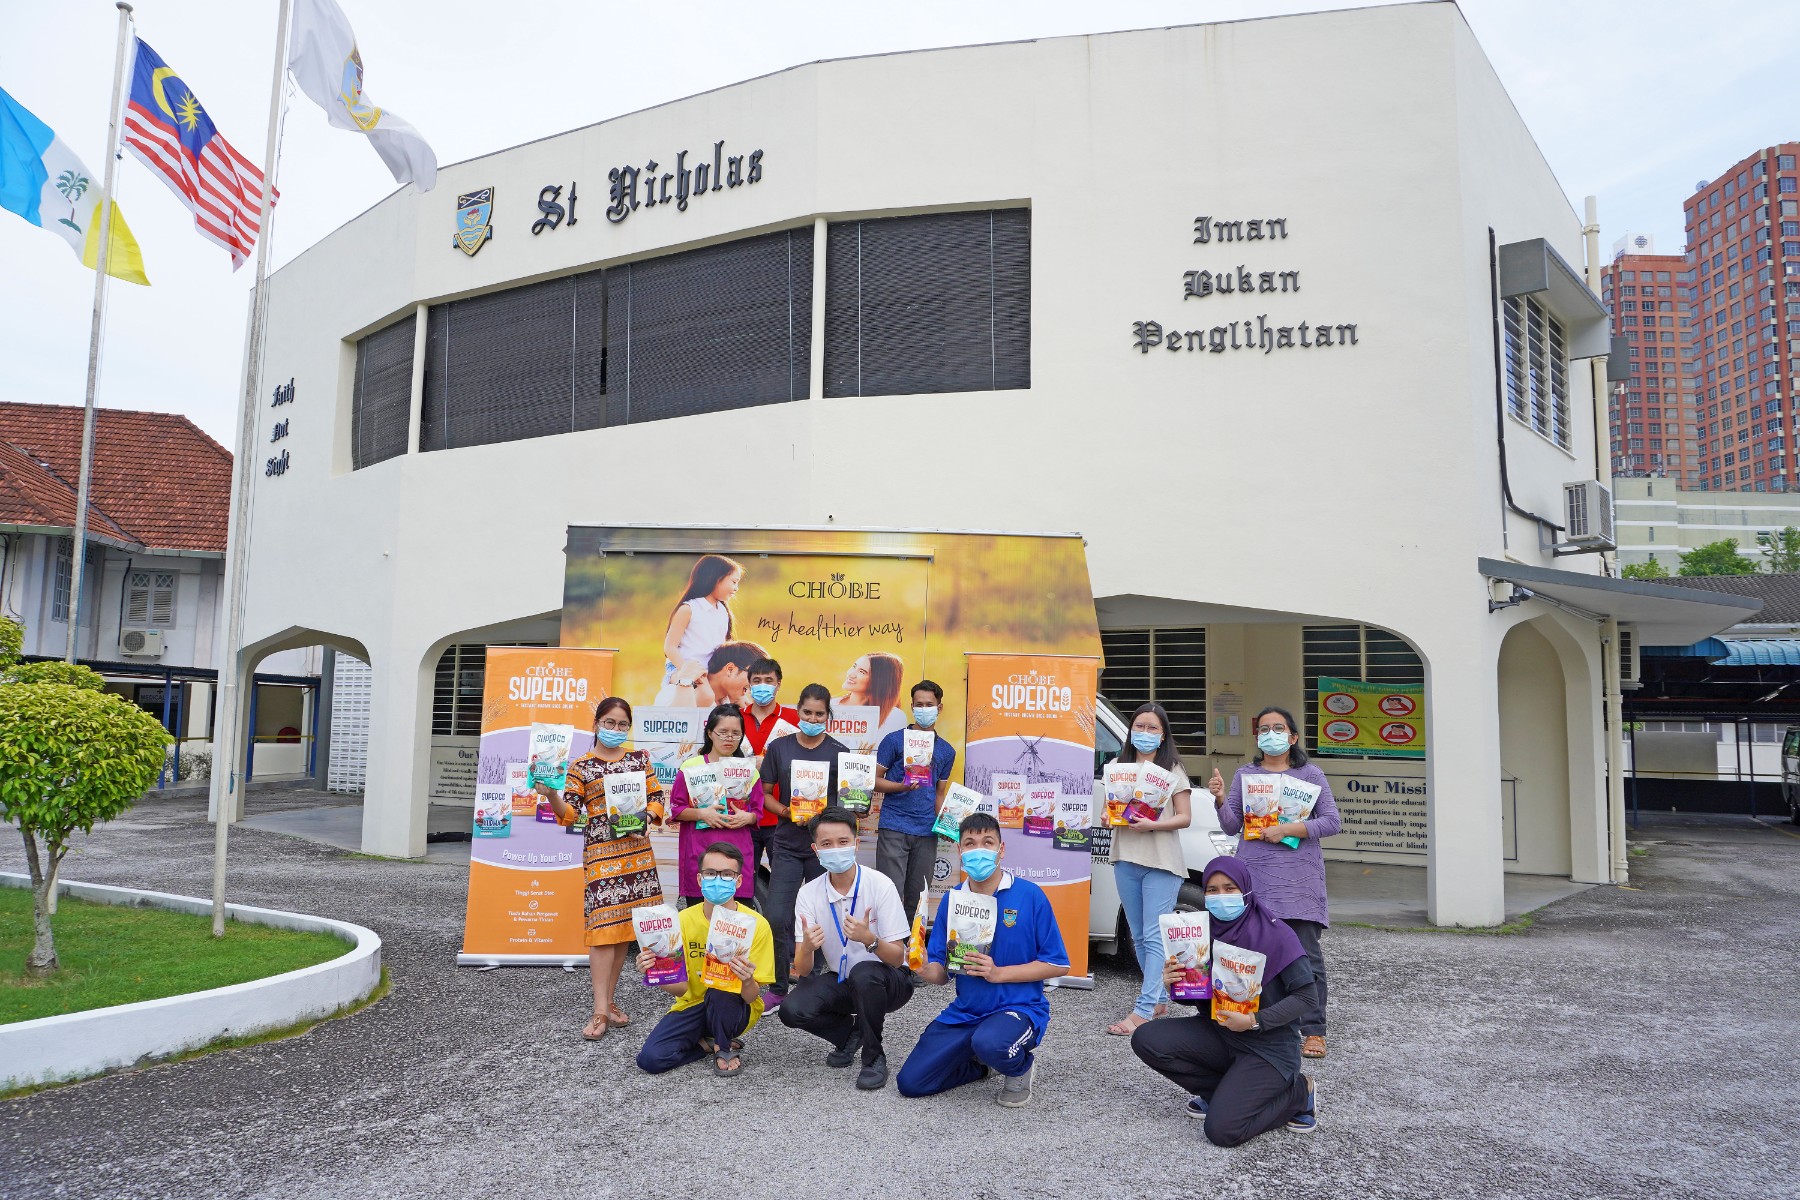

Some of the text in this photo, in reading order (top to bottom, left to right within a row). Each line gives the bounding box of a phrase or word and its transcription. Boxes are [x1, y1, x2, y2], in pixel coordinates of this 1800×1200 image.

[531, 139, 764, 236] St Nicholas
[1193, 215, 1288, 244] Iman
[1183, 264, 1300, 300] Bukan
[1132, 314, 1359, 354] Penglihatan
[788, 580, 881, 600] CHOBE
[757, 611, 904, 643] my healthier way
[526, 666, 573, 677] CHOBE
[1008, 674, 1056, 686] CHOBE
[825, 719, 868, 734] UPERGO
[458, 749, 474, 759] Our
[512, 770, 528, 779] SUPER
[654, 767, 678, 779] URMA
[1347, 779, 1427, 794] Our Missi
[1372, 798, 1399, 806] provide
[1343, 808, 1391, 816] opportunities
[1344, 817, 1362, 825] blind
[1379, 819, 1407, 828] visually
[1409, 820, 1427, 829] impa
[1358, 829, 1384, 837] society
[1385, 830, 1405, 838] while
[1356, 839, 1394, 847] prevention
[502, 849, 573, 864] Power Up Your Day
[1016, 866, 1026, 878] Up
[1028, 867, 1045, 878] Your
[1046, 867, 1061, 879] Day
[689, 950, 705, 959] CR
